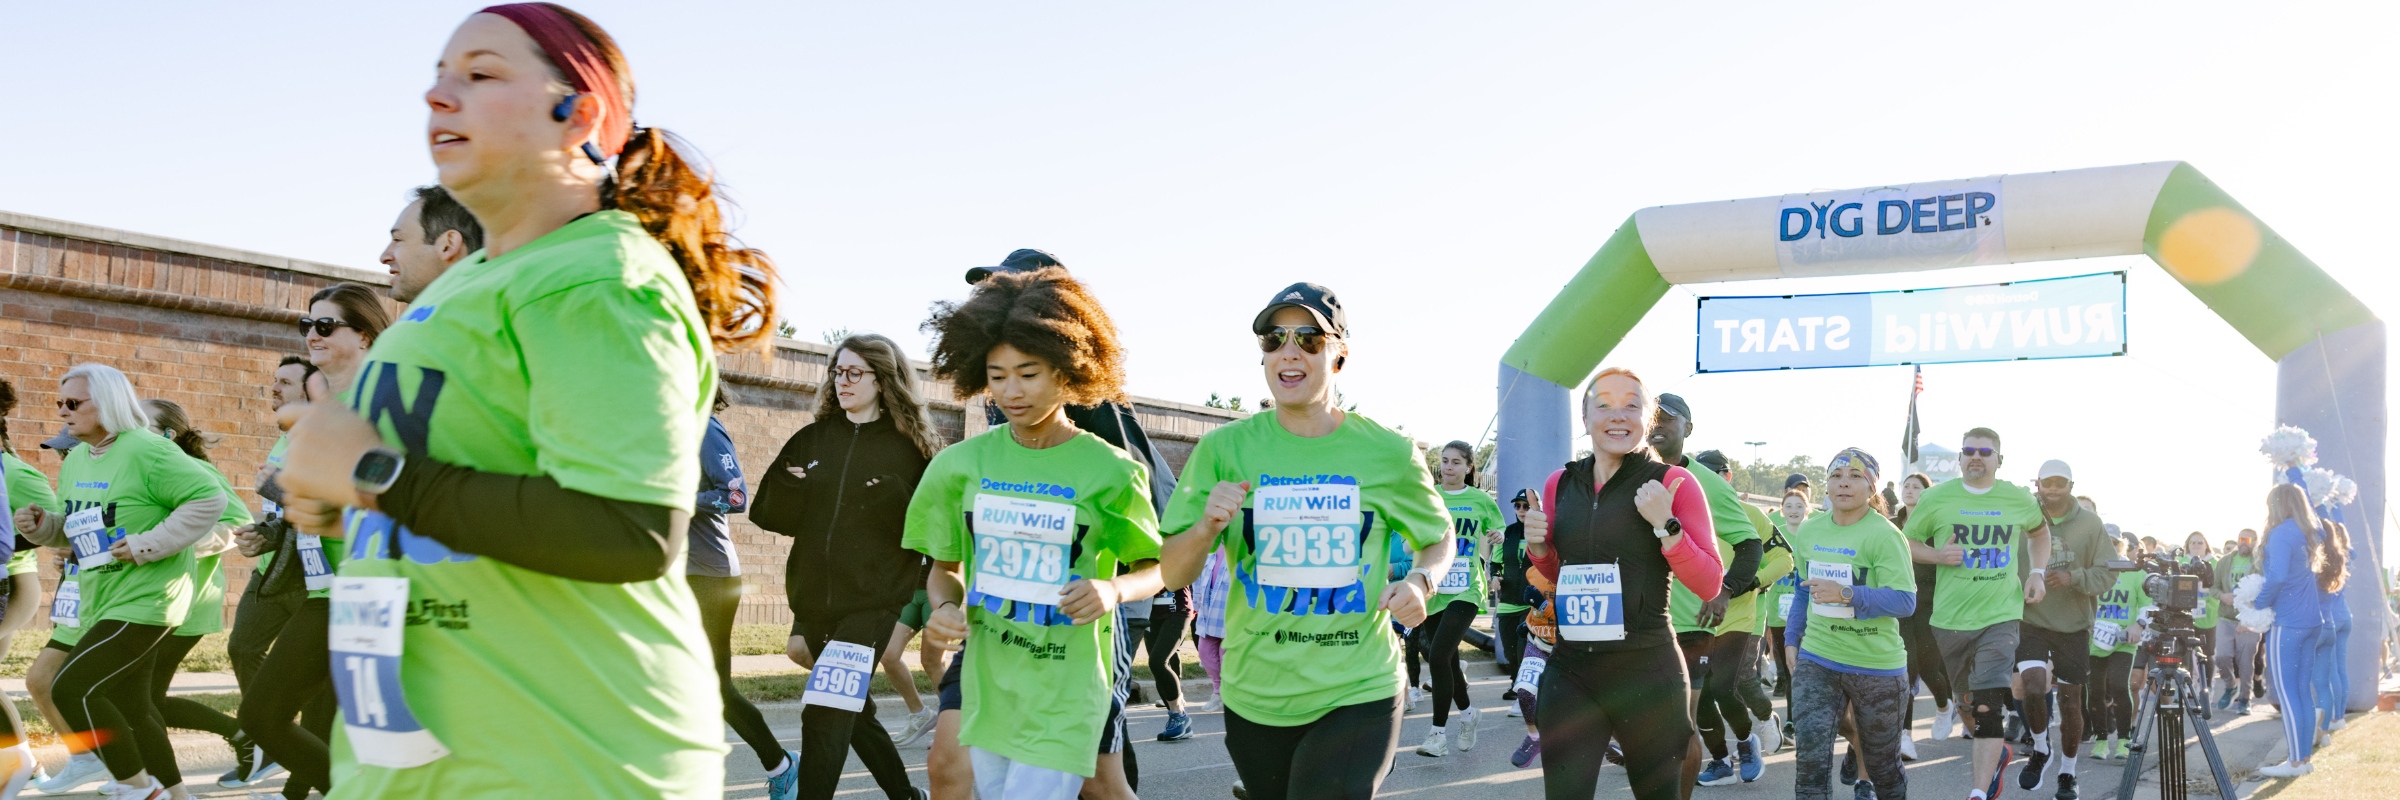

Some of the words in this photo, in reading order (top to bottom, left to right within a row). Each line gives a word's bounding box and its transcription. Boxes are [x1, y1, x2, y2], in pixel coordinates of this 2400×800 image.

[1877, 191, 1996, 235] DEEP
[981, 477, 1034, 494] Detroit
[1260, 473, 1314, 486] Detroit
[1263, 496, 1303, 511] RUN
[1304, 495, 1351, 510] Wild
[79, 513, 99, 526] Wild
[981, 507, 1020, 525] RUN
[1021, 511, 1066, 531] Wild
[74, 531, 101, 557] 109
[1952, 523, 2014, 546] RUN
[1258, 525, 1356, 566] 2933
[980, 536, 1063, 583] 2978
[1560, 574, 1583, 585] RUN
[1584, 572, 1615, 584] Wild
[1810, 567, 1825, 577] RUN
[1825, 568, 1848, 579] Wild
[2098, 589, 2130, 604] UN
[1565, 595, 1609, 625] 937
[2093, 627, 2117, 646] 1441
[842, 650, 870, 664] Wild
[813, 666, 862, 697] 596
